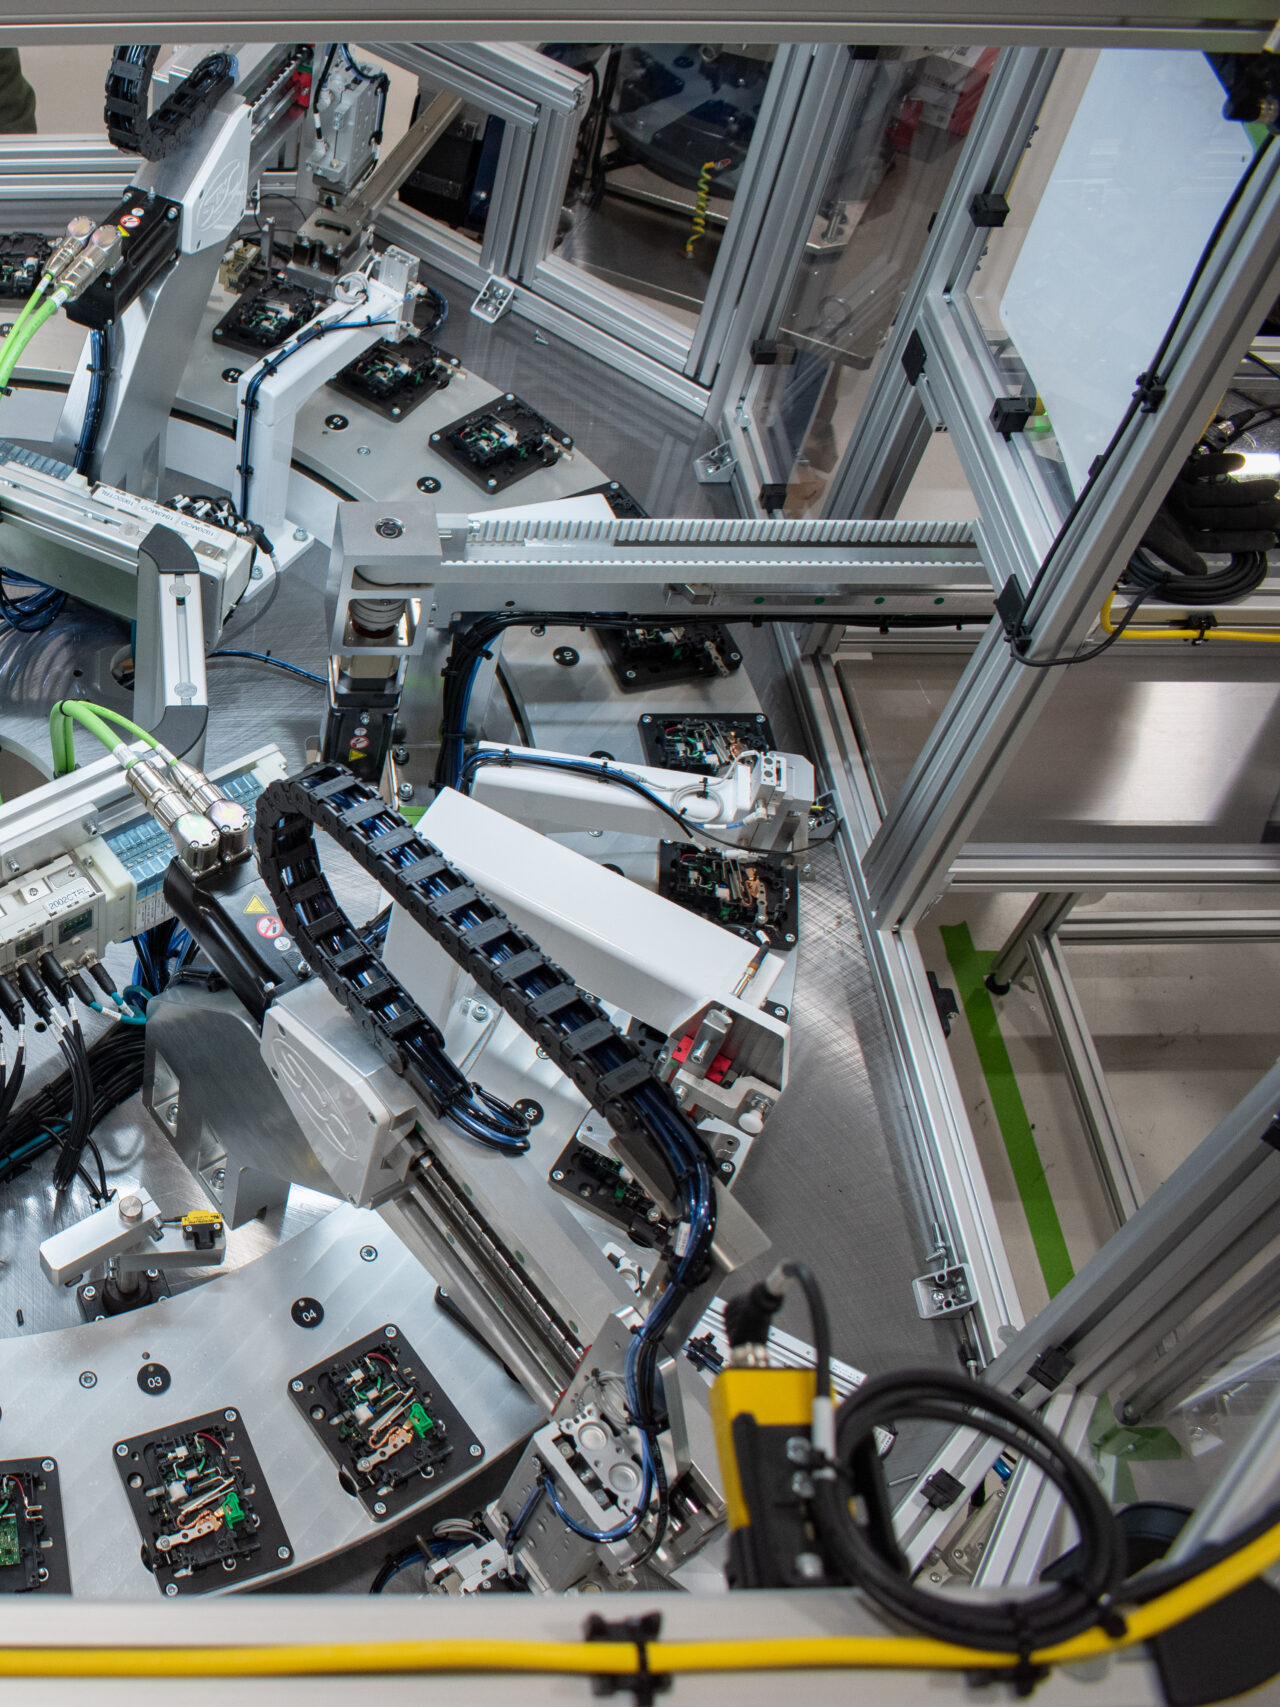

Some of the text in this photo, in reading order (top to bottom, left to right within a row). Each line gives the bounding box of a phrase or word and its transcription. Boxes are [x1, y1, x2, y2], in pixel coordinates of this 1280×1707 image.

[332, 418, 343, 426] 13
[424, 480, 436, 488] 12
[563, 651, 572, 661] 10
[524, 1107, 538, 1120] 06
[301, 1308, 317, 1322] 04
[147, 1376, 162, 1388] 03
